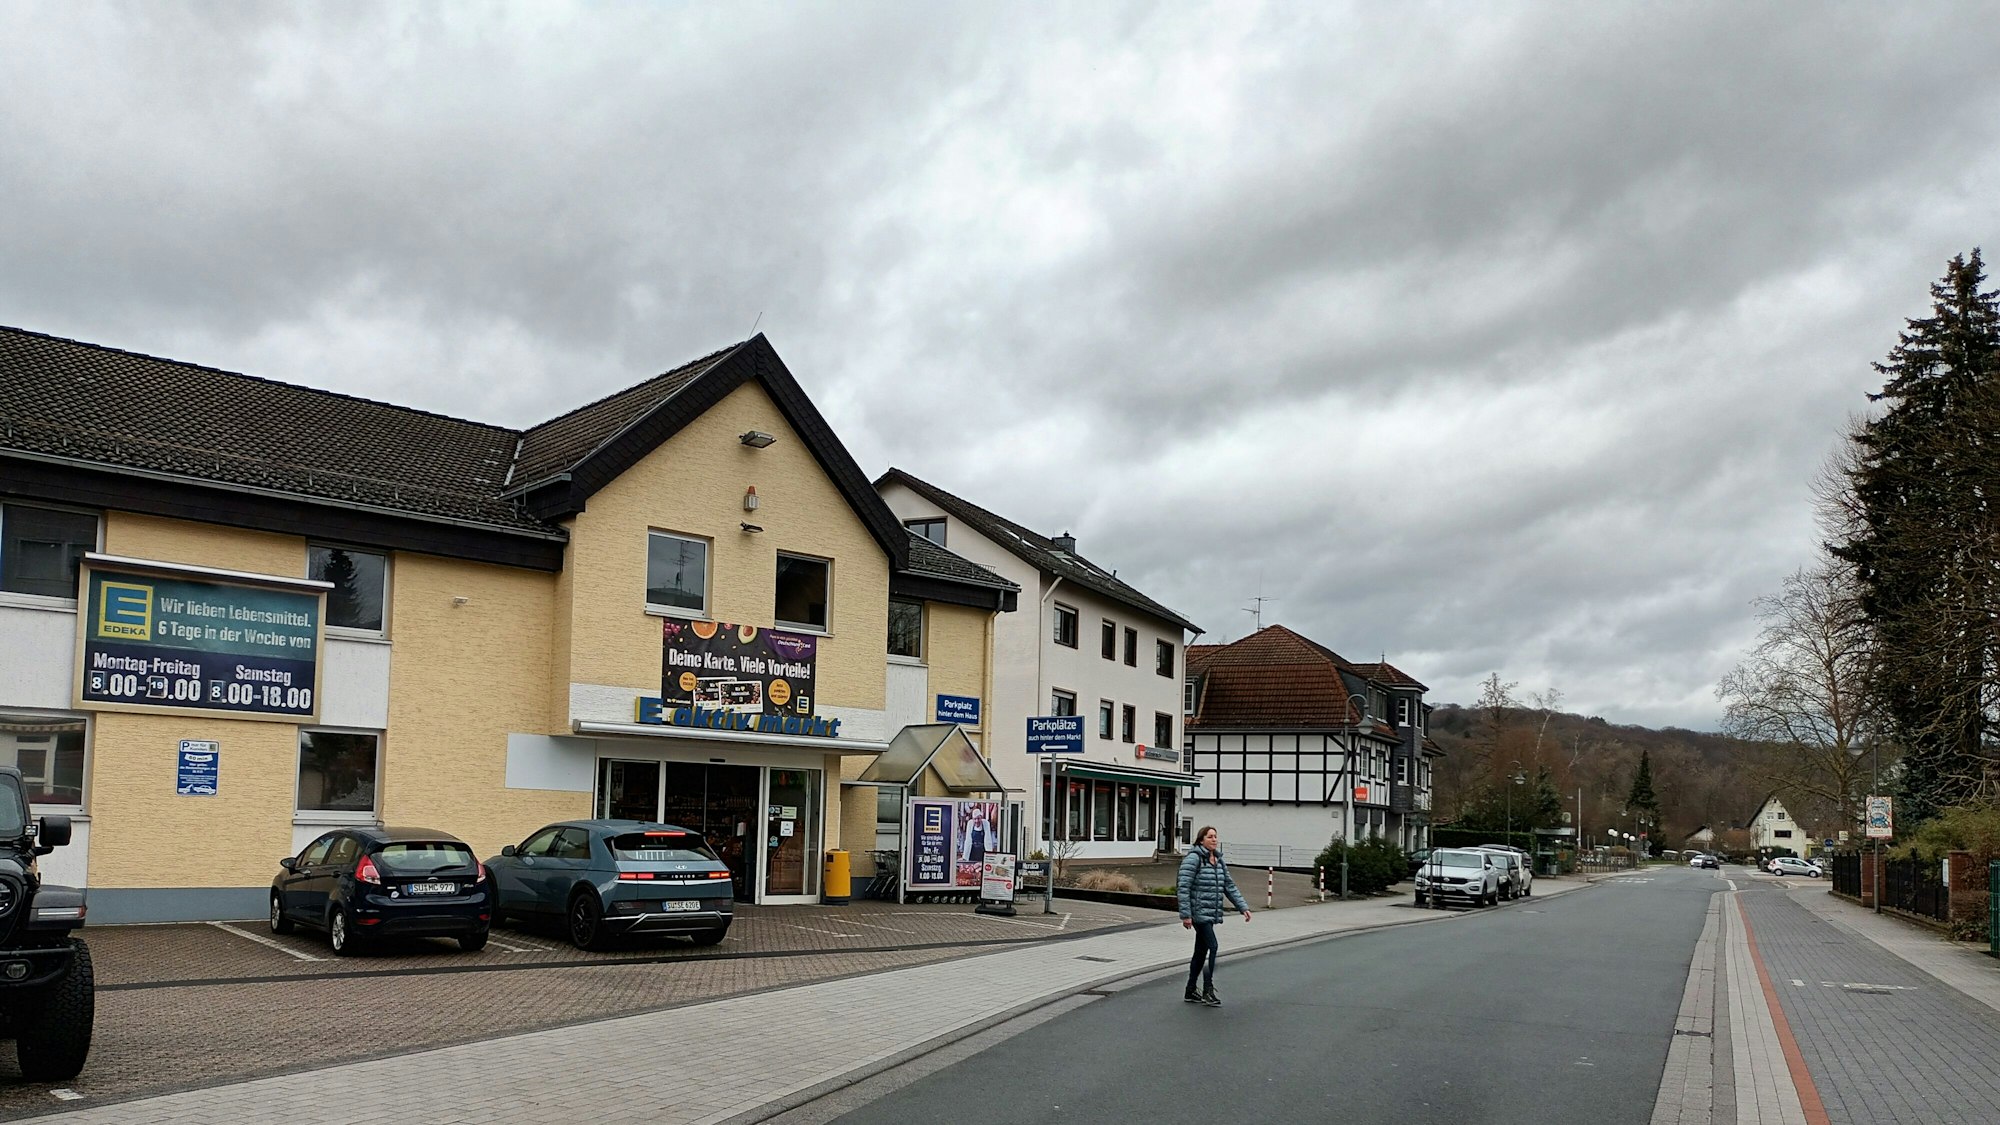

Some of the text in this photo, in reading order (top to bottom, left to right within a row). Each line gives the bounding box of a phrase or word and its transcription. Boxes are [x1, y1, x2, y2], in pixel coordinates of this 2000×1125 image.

[160, 597, 312, 627] Wir lieben Lebensmittel.
[103, 625, 146, 635] EDEKA
[158, 620, 311, 649] 6 Tage in der Woche von
[93, 652, 200, 679] Montag-Freitag
[668, 648, 811, 679] Deine Karte. Viele Vorteile!
[235, 664, 292, 686] Samstag
[211, 682, 311, 709] 8.00-18.00
[944, 699, 972, 710] Parkplatz
[669, 705, 750, 731] aktiv
[753, 714, 841, 738] markt
[938, 710, 978, 720] hinter dem Haus
[1032, 719, 1077, 733] Parkplätze
[1040, 733, 1054, 741] hinter
[413, 883, 454, 892] SU MC 977
